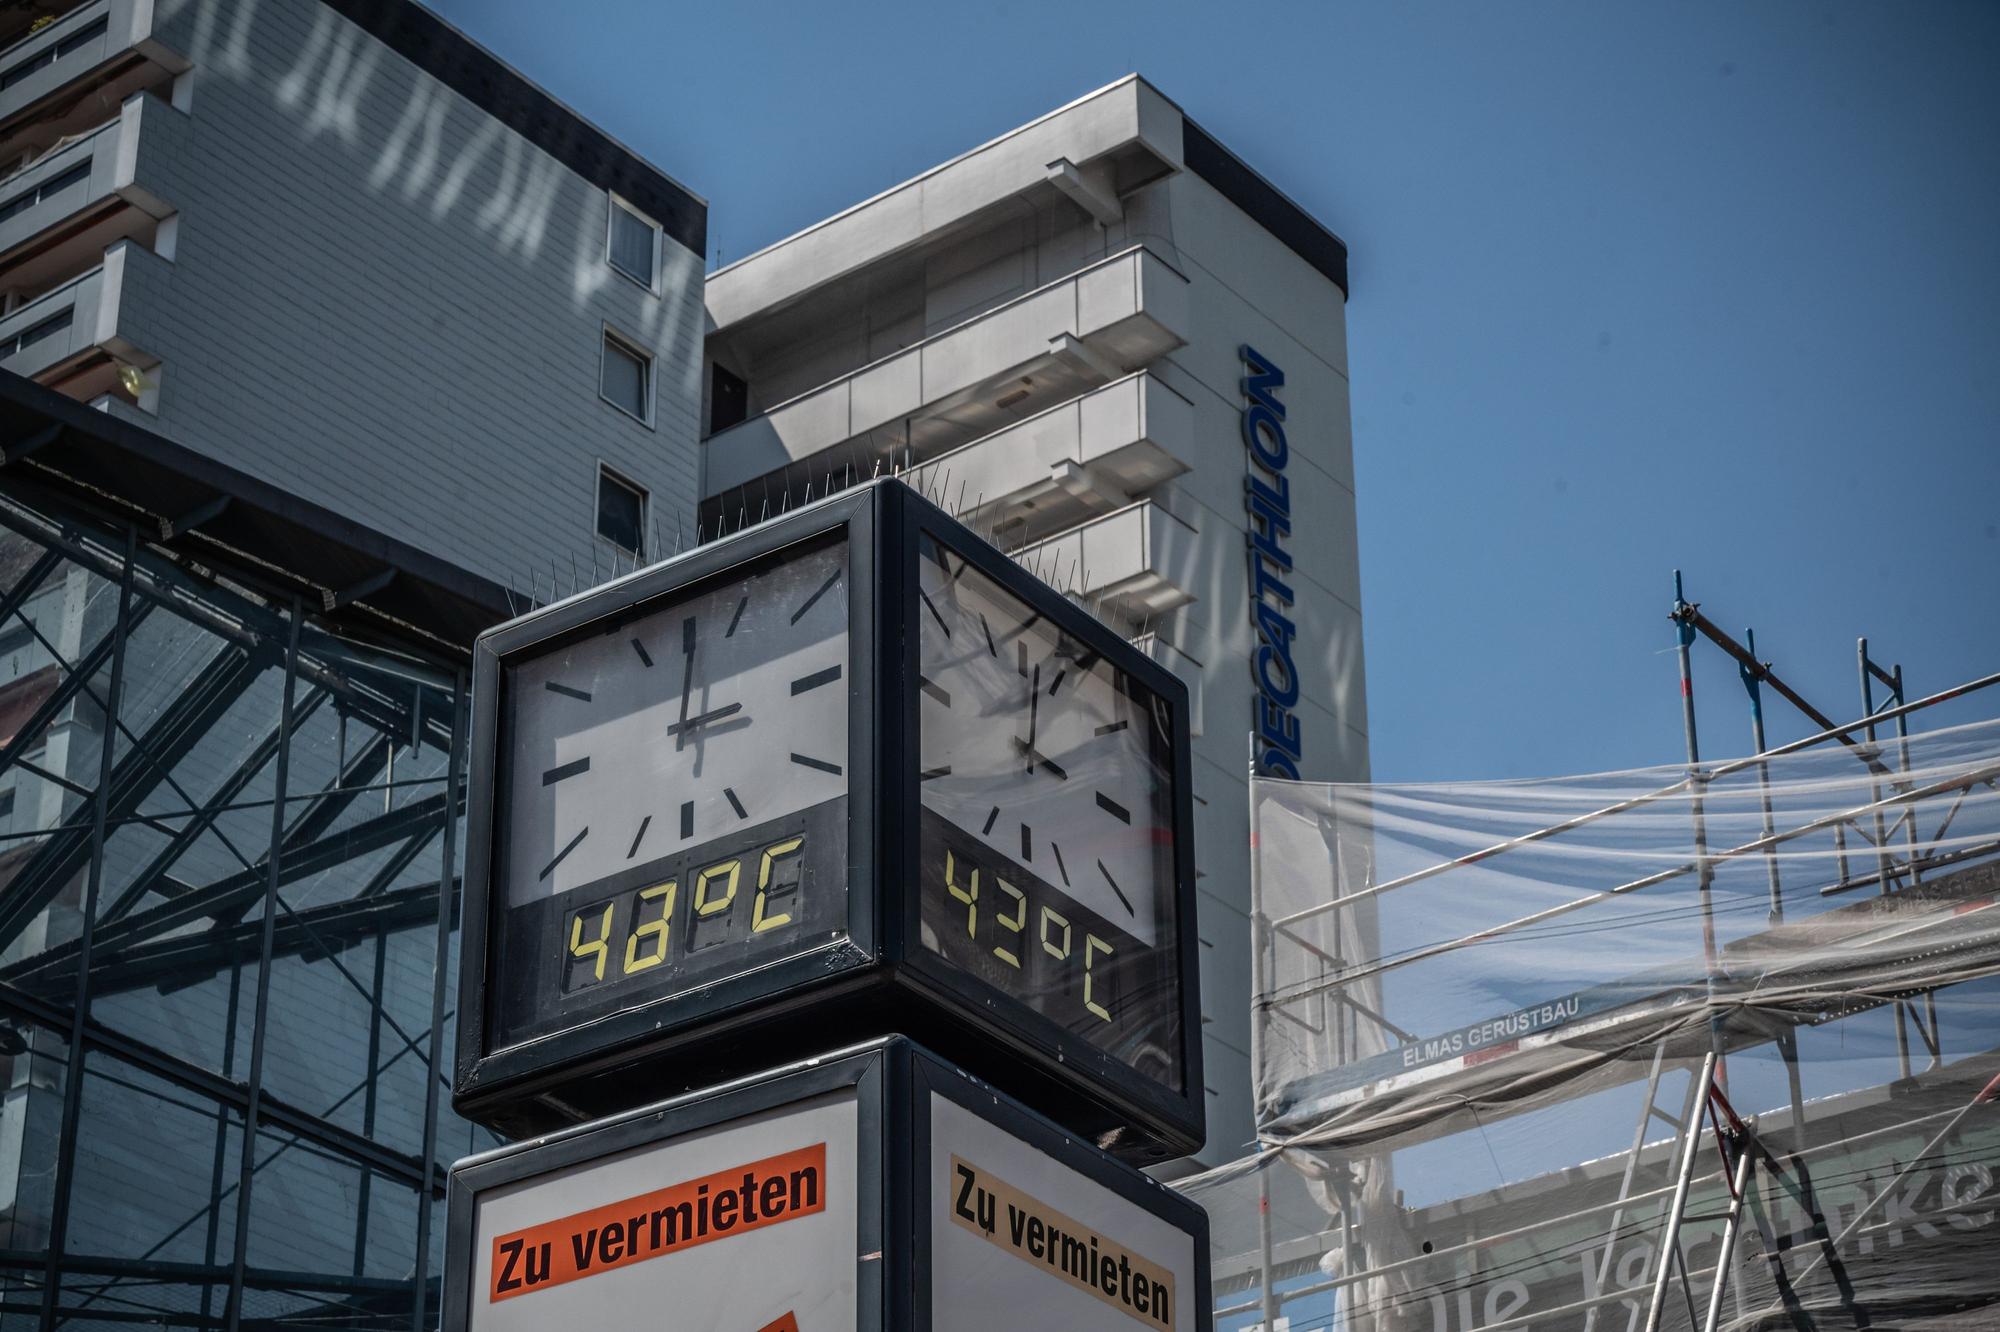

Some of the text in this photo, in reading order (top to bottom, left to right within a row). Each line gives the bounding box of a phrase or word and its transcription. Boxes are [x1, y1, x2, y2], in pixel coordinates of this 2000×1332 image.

[1403, 997, 1579, 1067] ELMAS GERÜSTBAU
[497, 1163, 819, 1294] Zu vermieten
[955, 1163, 1170, 1325] Zu vermieten
